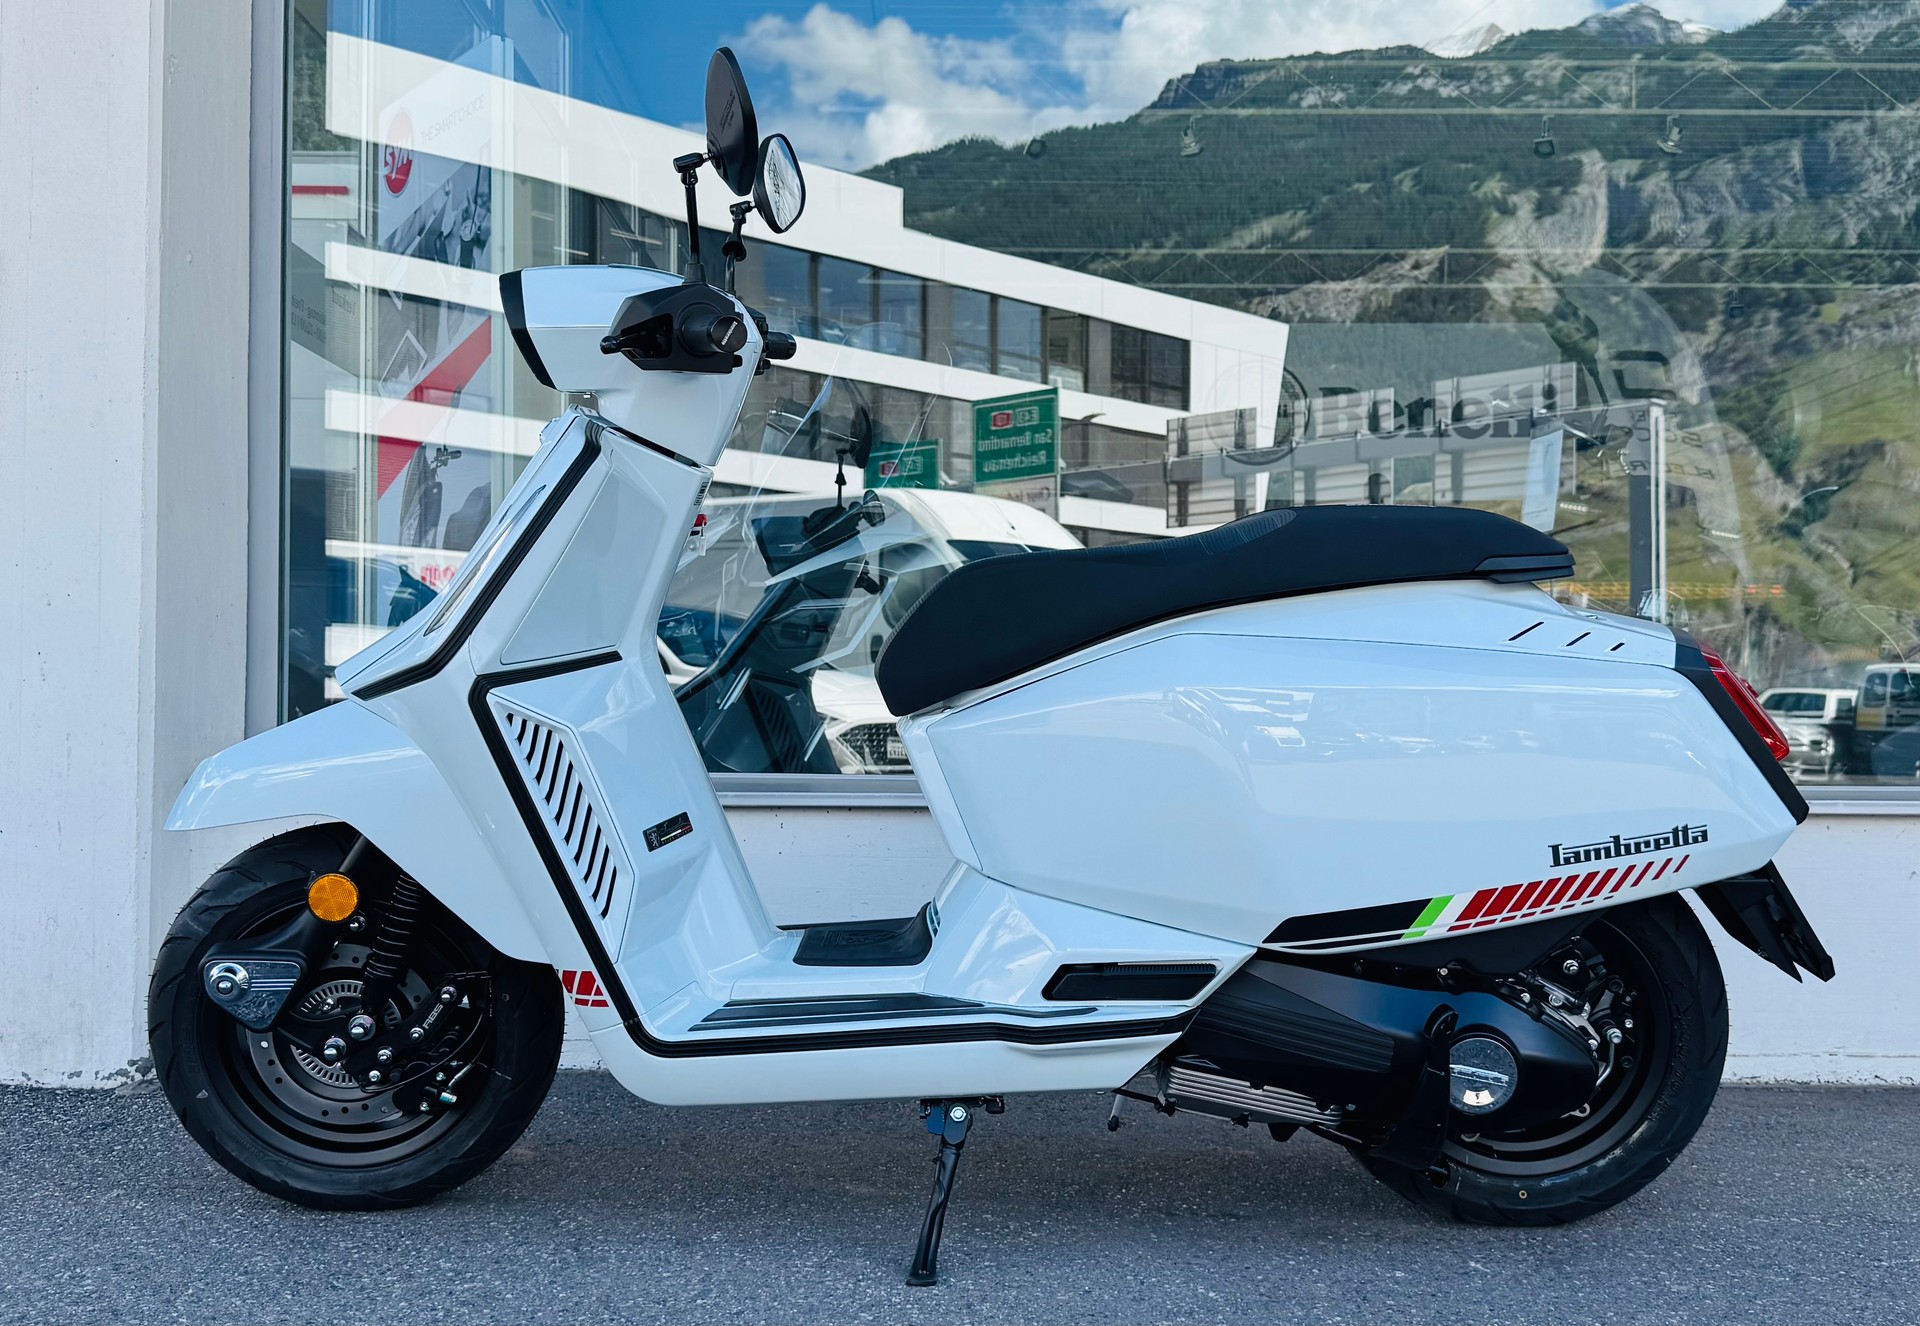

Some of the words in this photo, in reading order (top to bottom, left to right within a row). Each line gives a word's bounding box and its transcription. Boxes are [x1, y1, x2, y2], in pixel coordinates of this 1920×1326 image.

[1316, 383, 1559, 440] Benelli
[1548, 824, 1708, 867] Lambretta
[423, 1003, 443, 1029] ABS
